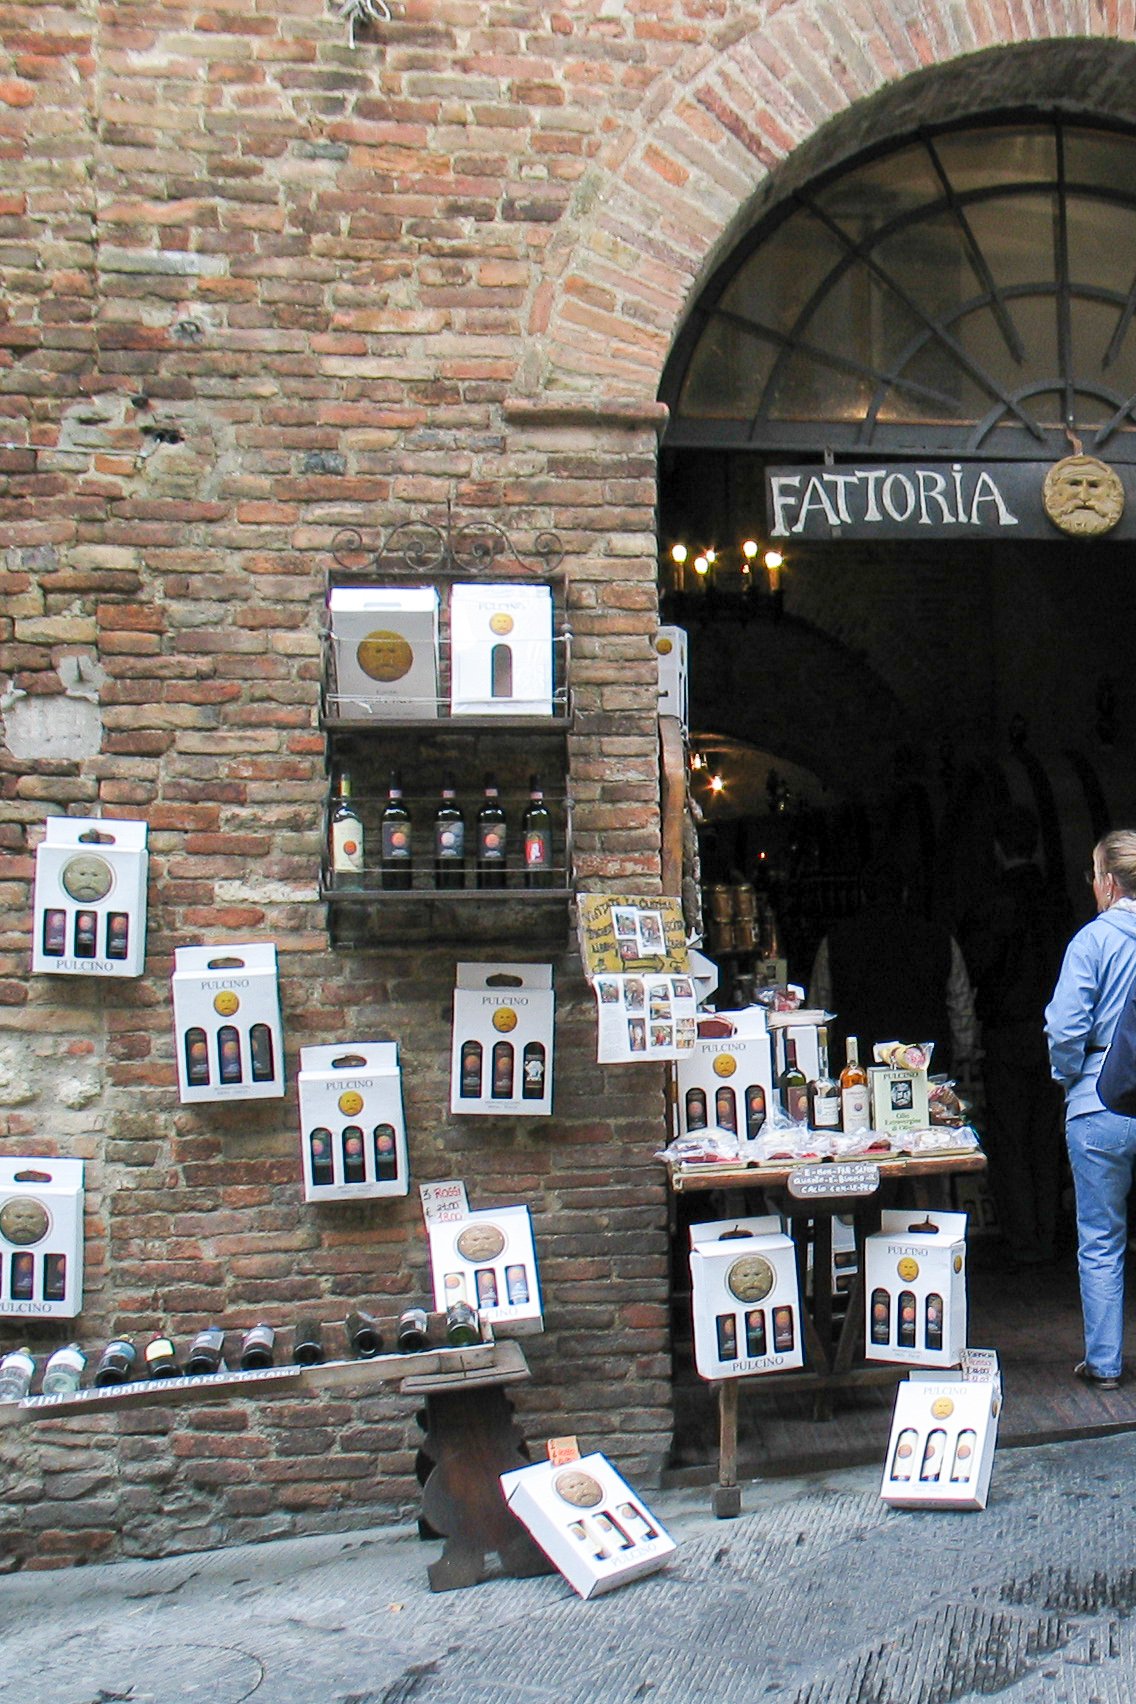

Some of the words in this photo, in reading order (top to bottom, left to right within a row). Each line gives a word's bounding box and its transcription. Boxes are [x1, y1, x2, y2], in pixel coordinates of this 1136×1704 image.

[769, 464, 1019, 537] FATTORIA
[56, 958, 115, 972] PULCINO
[200, 978, 250, 991] PULCINO
[481, 996, 529, 1006] PULCINO
[702, 1042, 747, 1054] PULCINO
[325, 1079, 374, 1091] PULCINO
[888, 1245, 930, 1257] PULCINO
[0, 1302, 53, 1314] ULCINO
[732, 1355, 785, 1373] PULCINO
[923, 1386, 969, 1397] PULCINO
